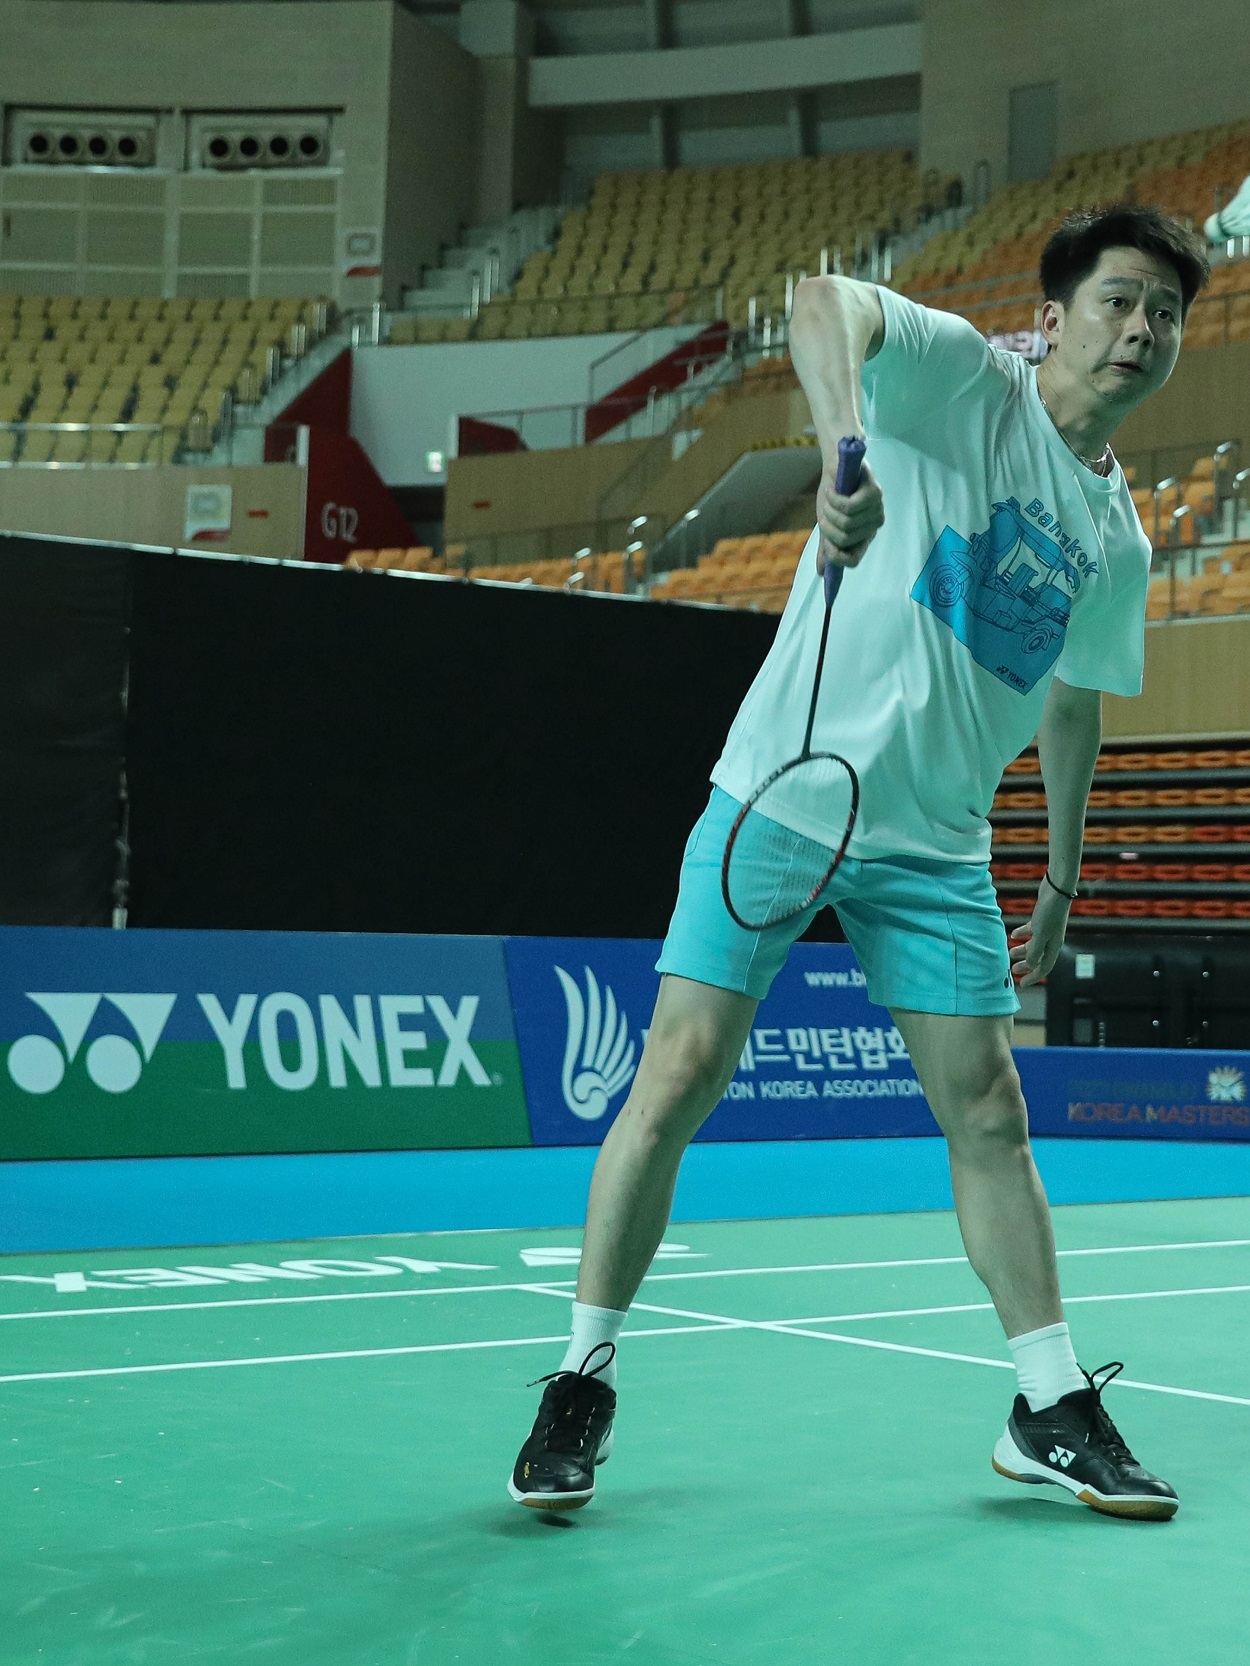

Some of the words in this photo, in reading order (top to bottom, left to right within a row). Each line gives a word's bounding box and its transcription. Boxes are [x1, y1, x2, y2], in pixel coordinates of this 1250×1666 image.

[321, 502, 358, 543] G12
[1024, 498, 1099, 579] Bangkok
[1007, 671, 1028, 688] YONEX
[196, 991, 492, 1091] YONEX
[759, 1080, 819, 1099] KOREA
[822, 1078, 924, 1099] ASSOCIATION
[1067, 1102, 1143, 1122] KOREA
[1146, 1104, 1250, 1126] MASTERS
